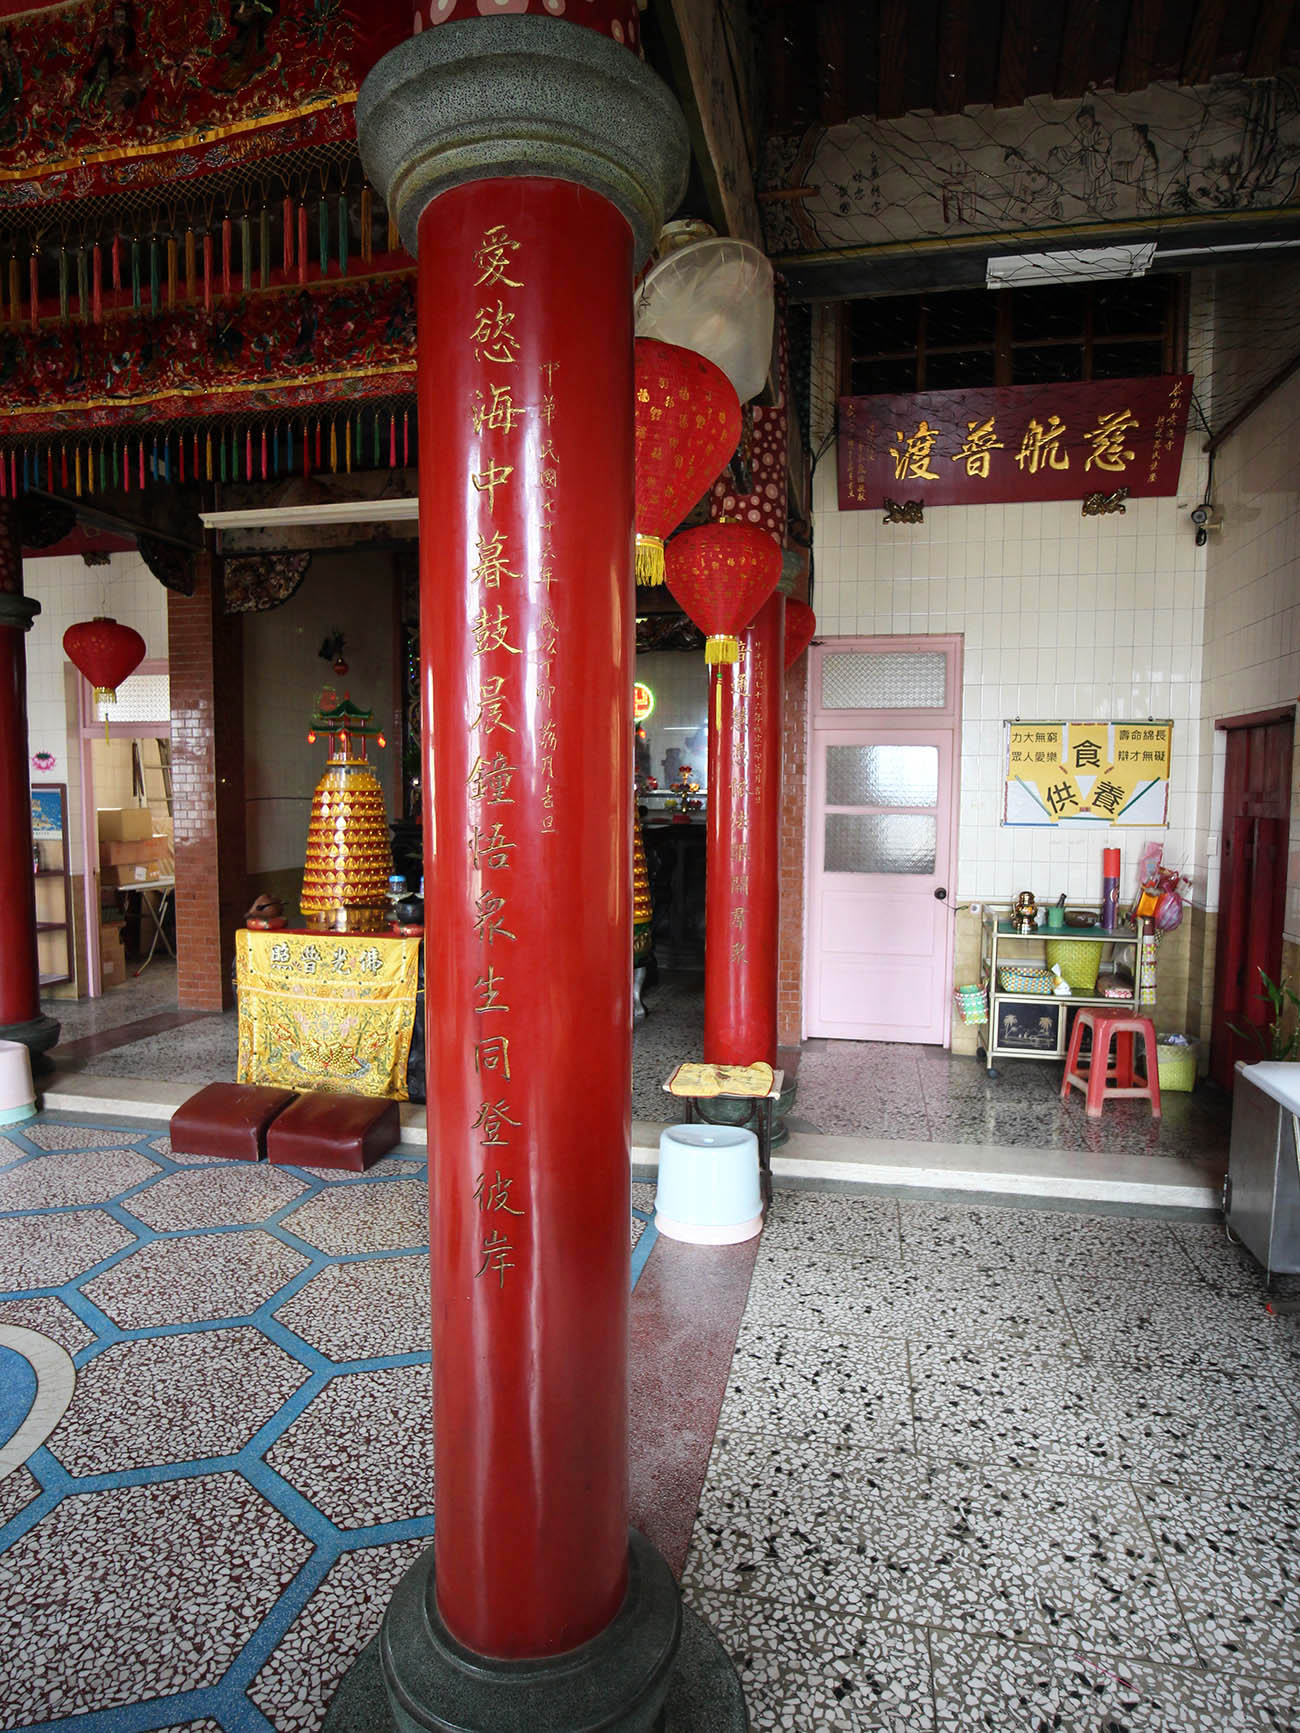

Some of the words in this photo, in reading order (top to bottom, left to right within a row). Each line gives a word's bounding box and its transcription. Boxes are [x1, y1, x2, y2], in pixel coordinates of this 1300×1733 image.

[1011, 732, 1058, 744] 力大無窮
[1118, 729, 1167, 742] 壽命綿長
[1011, 751, 1058, 763] 眾人愛樂
[1072, 740, 1102, 769] 食
